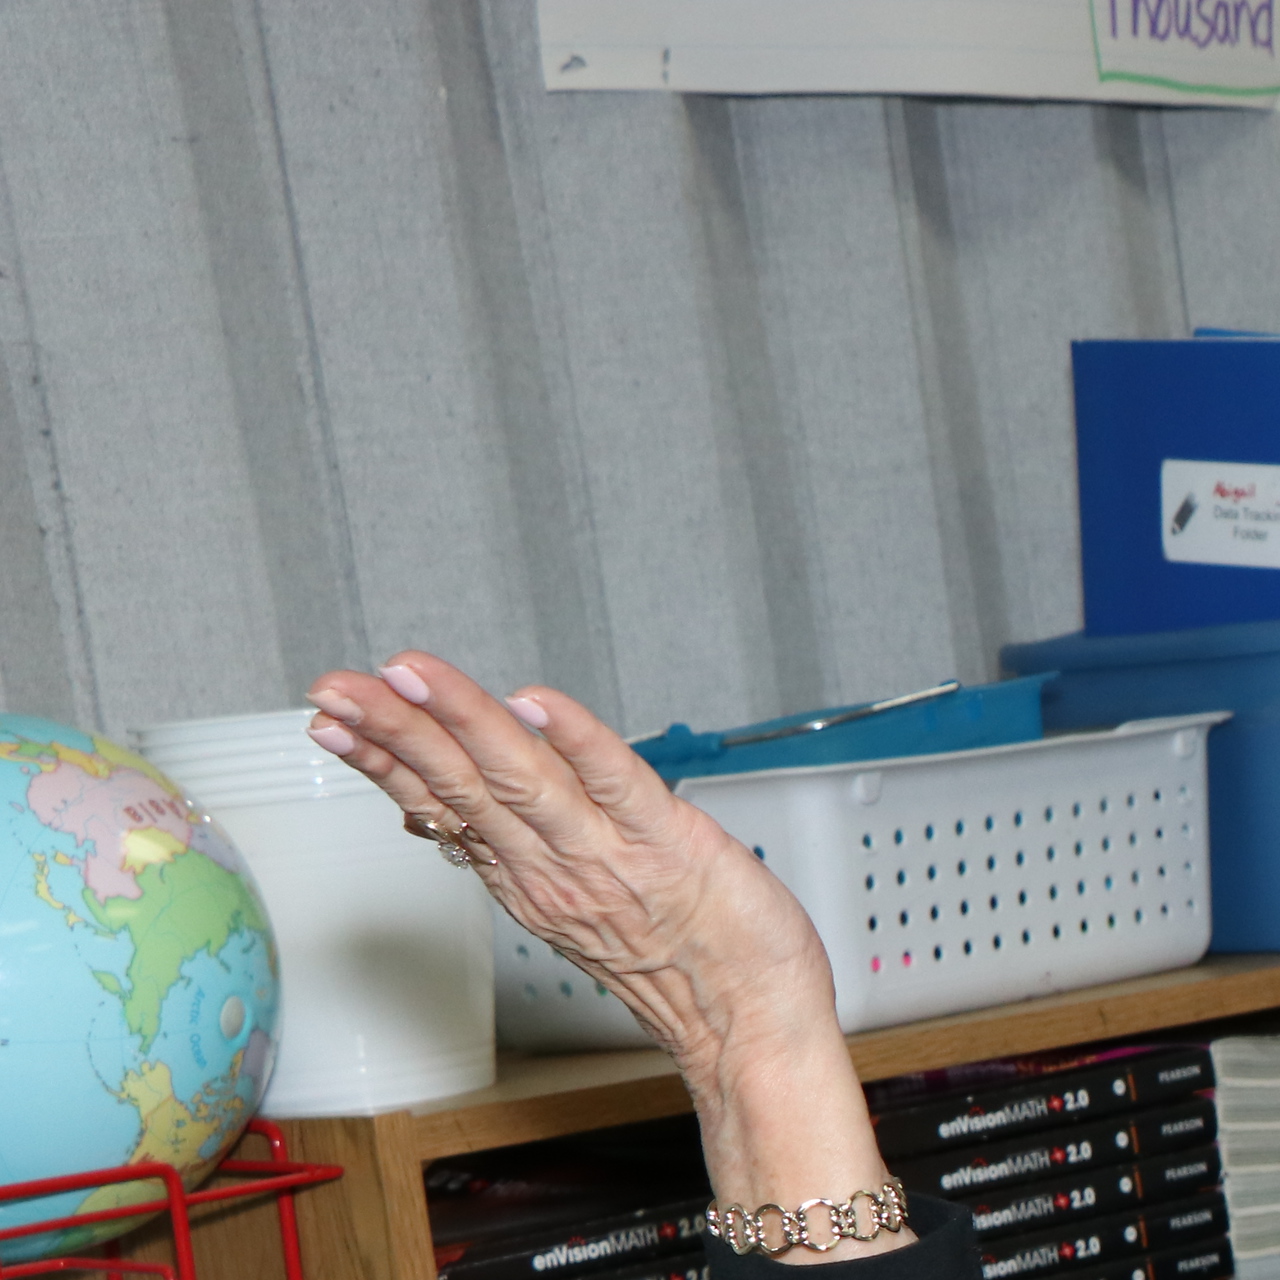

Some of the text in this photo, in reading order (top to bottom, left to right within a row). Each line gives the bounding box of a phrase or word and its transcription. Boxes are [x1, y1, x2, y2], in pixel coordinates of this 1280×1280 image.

[1233, 526, 1268, 541] Folder
[1064, 1089, 1091, 1113] 2.0
[1159, 1065, 1201, 1083] PEARSON
[1066, 1140, 1093, 1164] 2.0
[1161, 1118, 1204, 1135] PEARSON
[1069, 1186, 1097, 1210] 2.0
[1165, 1162, 1208, 1181] PEARSON
[677, 1213, 706, 1239] 2.0
[1075, 1234, 1102, 1260] 2.0
[1170, 1210, 1213, 1229] PEARSON
[1177, 1253, 1220, 1272] PEARSON
